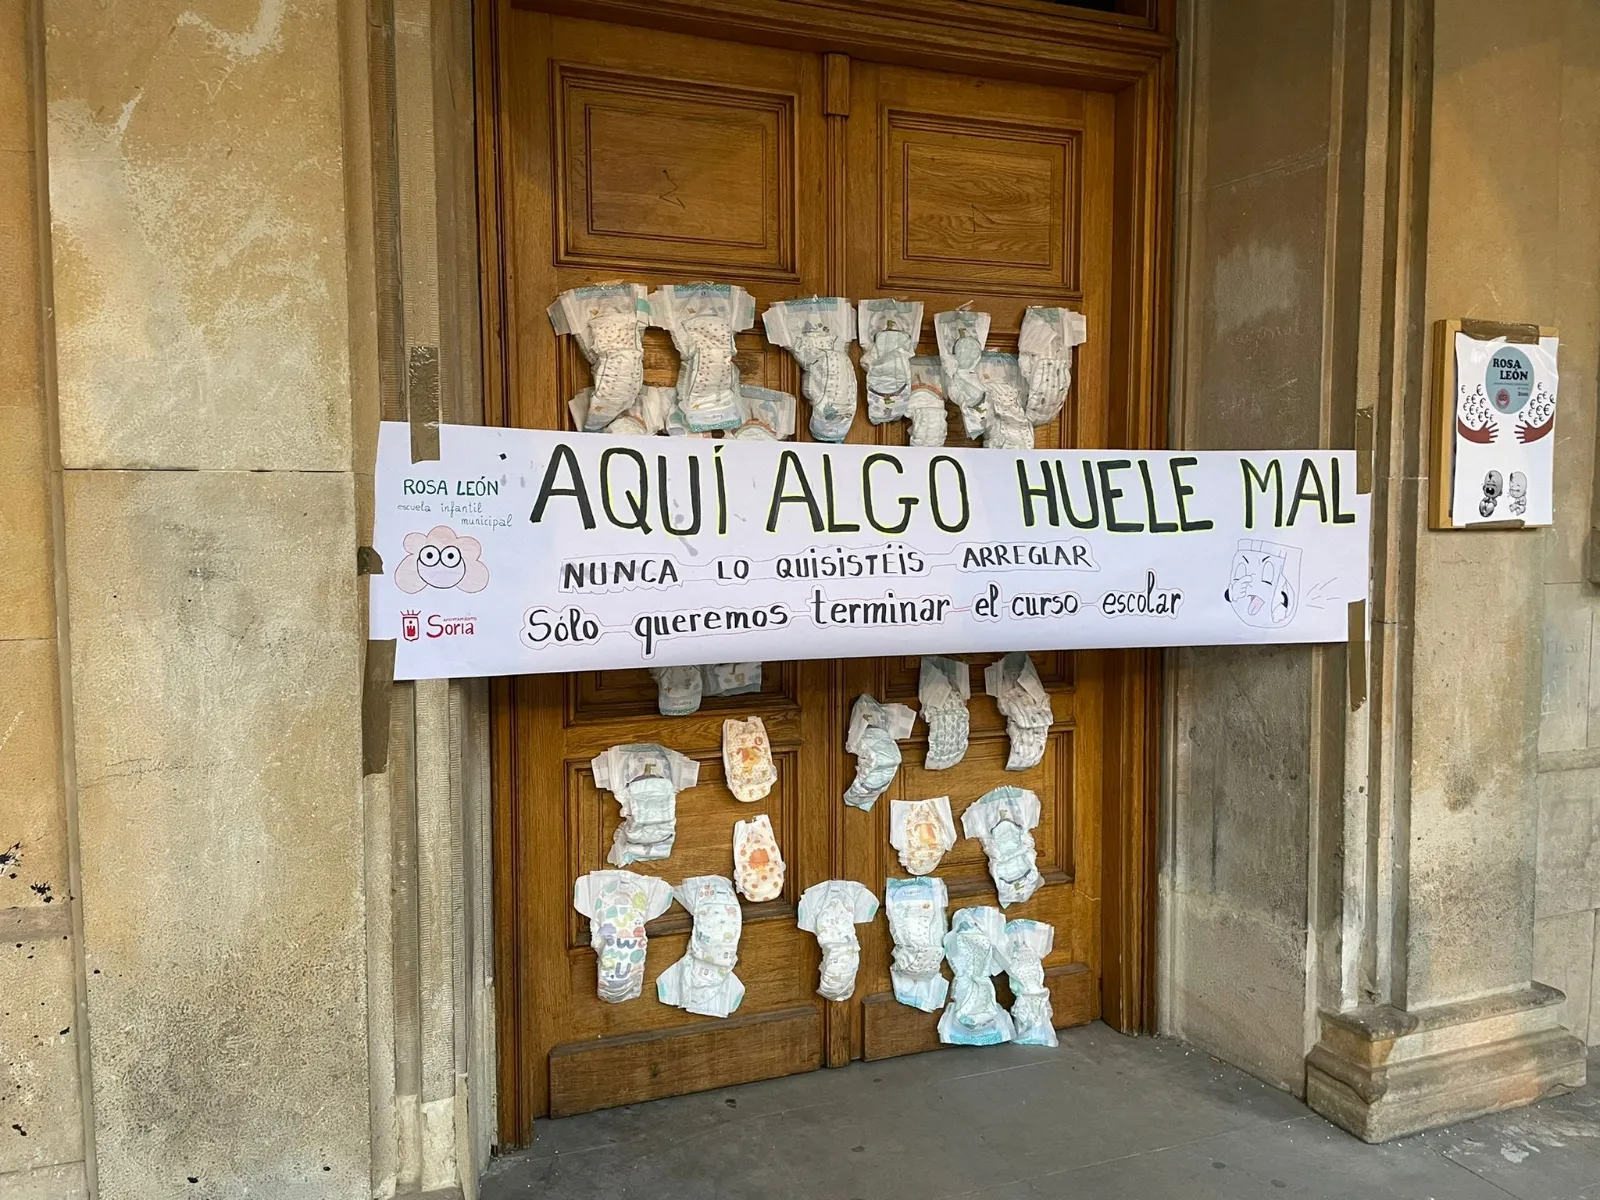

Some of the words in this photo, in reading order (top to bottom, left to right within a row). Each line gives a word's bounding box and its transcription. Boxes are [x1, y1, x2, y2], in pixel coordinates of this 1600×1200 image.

[1493, 358, 1522, 369] ROSA
[1500, 369, 1528, 380] LEÓN
[403, 478, 448, 496] ROSA
[456, 476, 499, 497] LEÓN
[529, 443, 727, 536] AQUÍ
[765, 449, 970, 534] ALGO
[1016, 456, 1214, 534] HUELE
[1239, 457, 1356, 530] MAL
[397, 500, 432, 512] escuela
[440, 500, 482, 518] infantil
[461, 513, 513, 532] municipal
[563, 559, 678, 589] NUNCA
[717, 559, 749, 580] LO
[962, 544, 1092, 569] ARREGLAR
[527, 608, 599, 642] Sólo
[634, 605, 788, 656] queremos
[812, 589, 951, 625] terminar
[975, 583, 999, 618] el
[1011, 594, 1078, 617] curso
[1102, 571, 1181, 615] escolar
[426, 614, 474, 638] Soria
